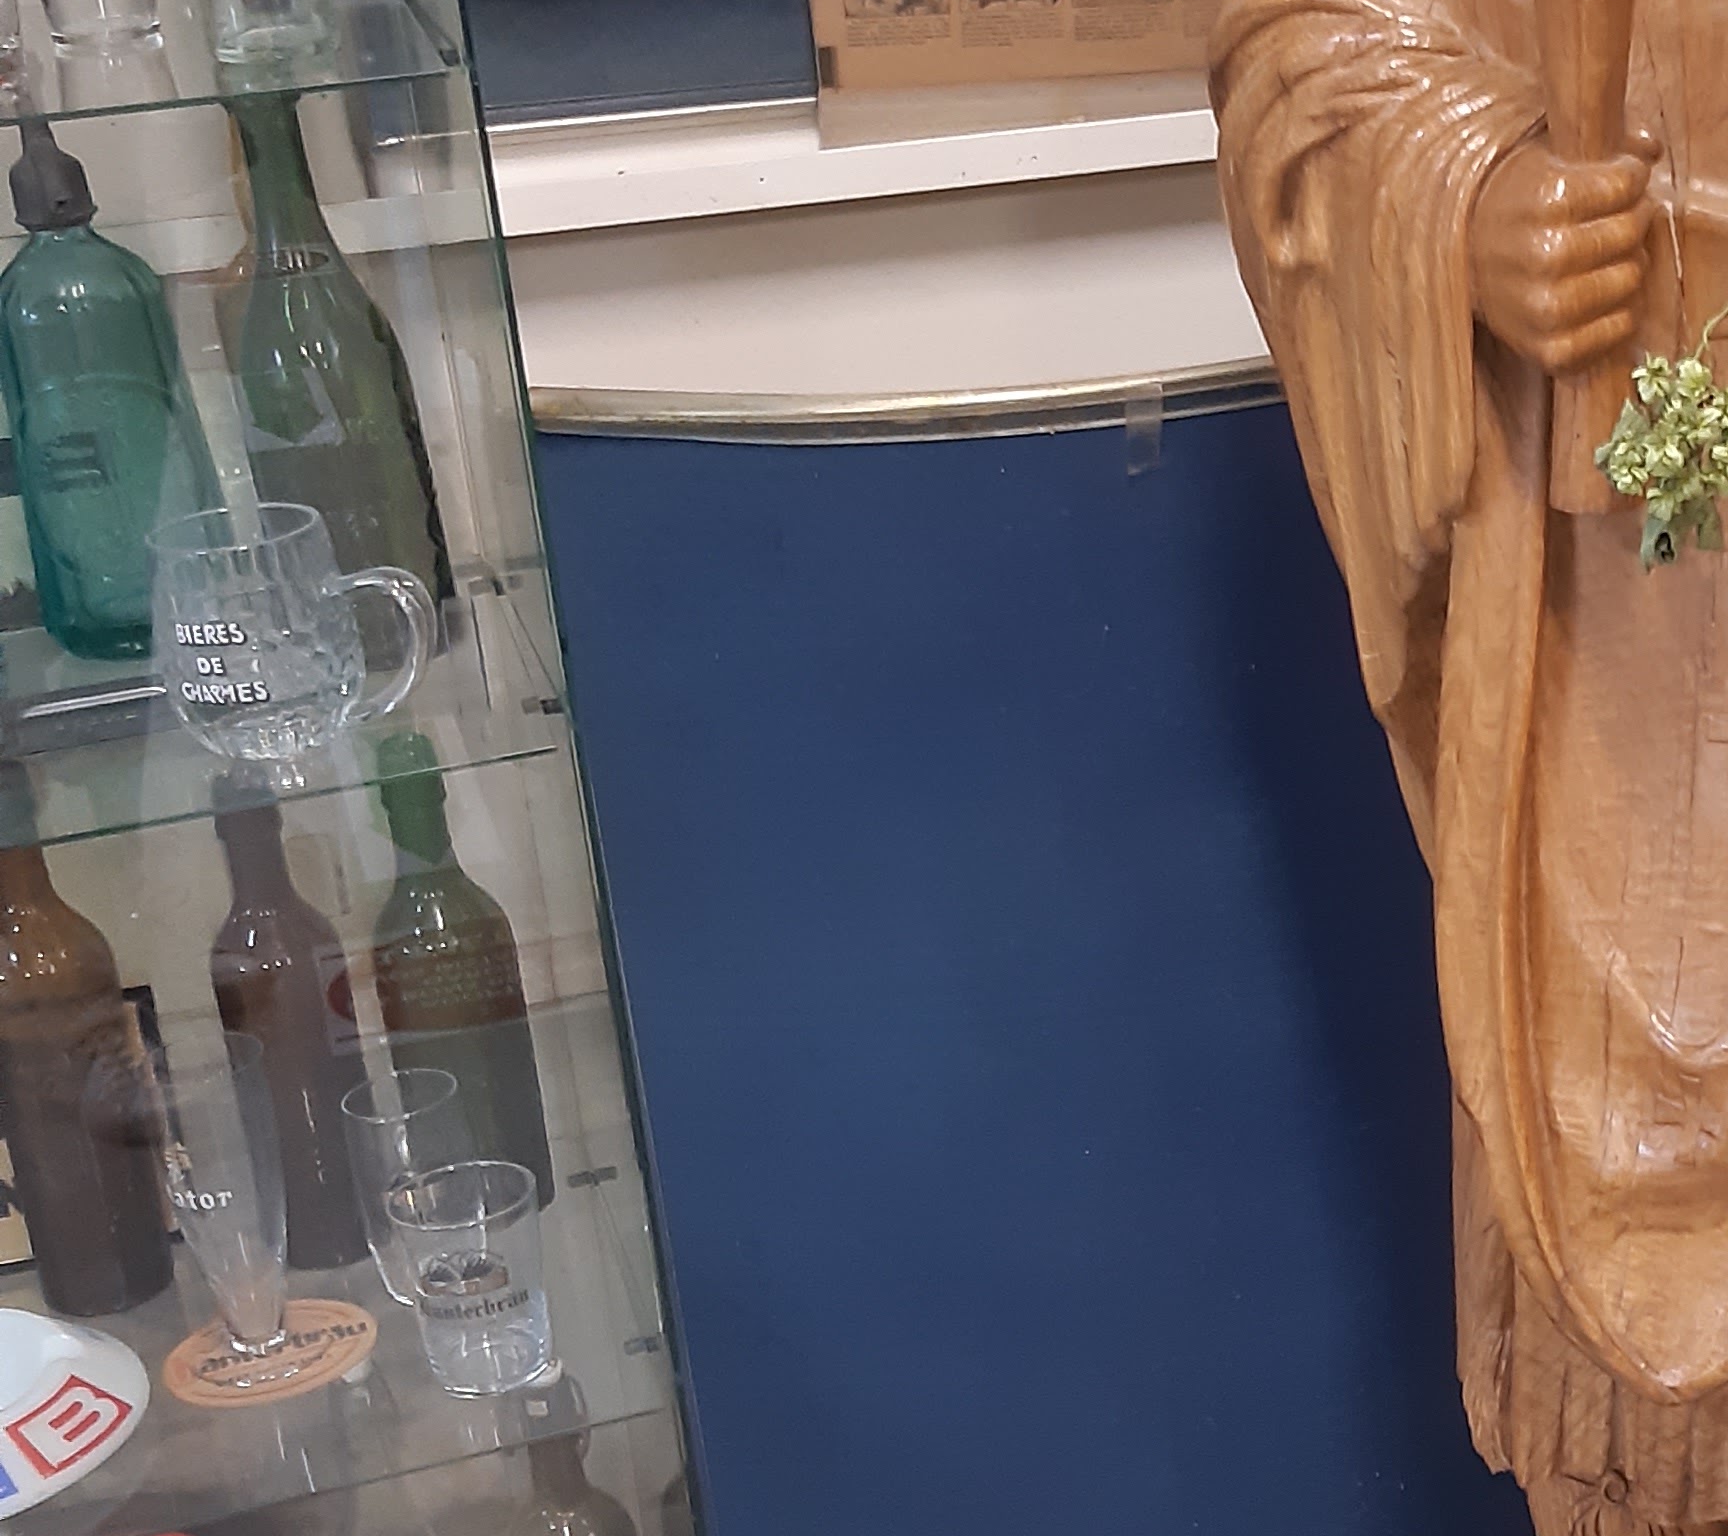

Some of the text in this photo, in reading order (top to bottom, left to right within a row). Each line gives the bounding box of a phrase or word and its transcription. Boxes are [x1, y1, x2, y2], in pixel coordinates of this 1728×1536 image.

[174, 622, 245, 645] BIERES
[196, 656, 224, 675] DE
[181, 680, 270, 705] CHARMES
[172, 1189, 235, 1212] ator
